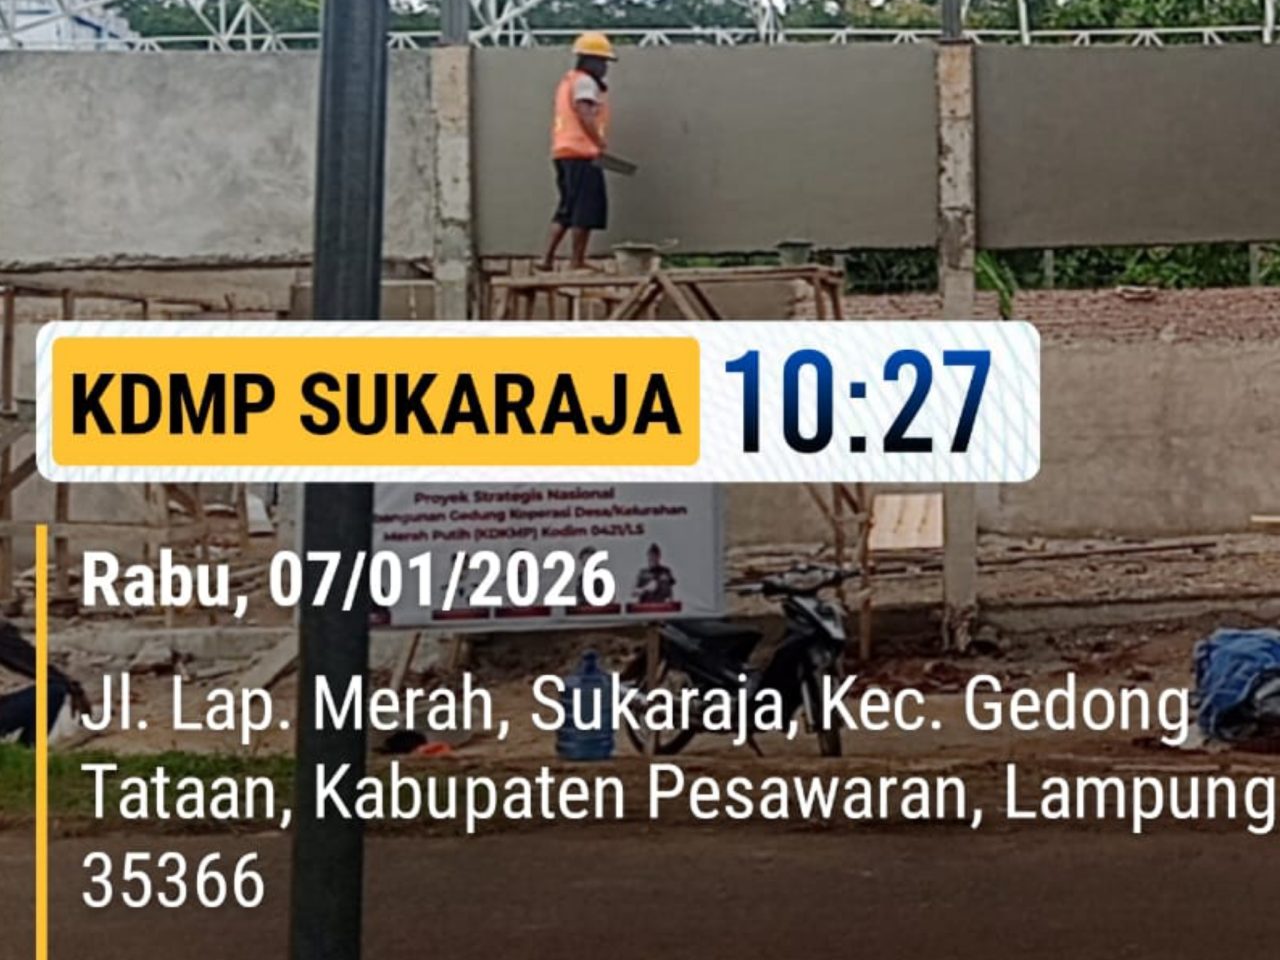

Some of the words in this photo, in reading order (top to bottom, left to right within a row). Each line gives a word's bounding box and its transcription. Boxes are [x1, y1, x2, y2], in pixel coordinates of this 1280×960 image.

[413, 491, 469, 506] Proyek
[473, 490, 543, 505] Strategis
[547, 487, 615, 500] Nasional
[432, 528, 471, 541] Putih
